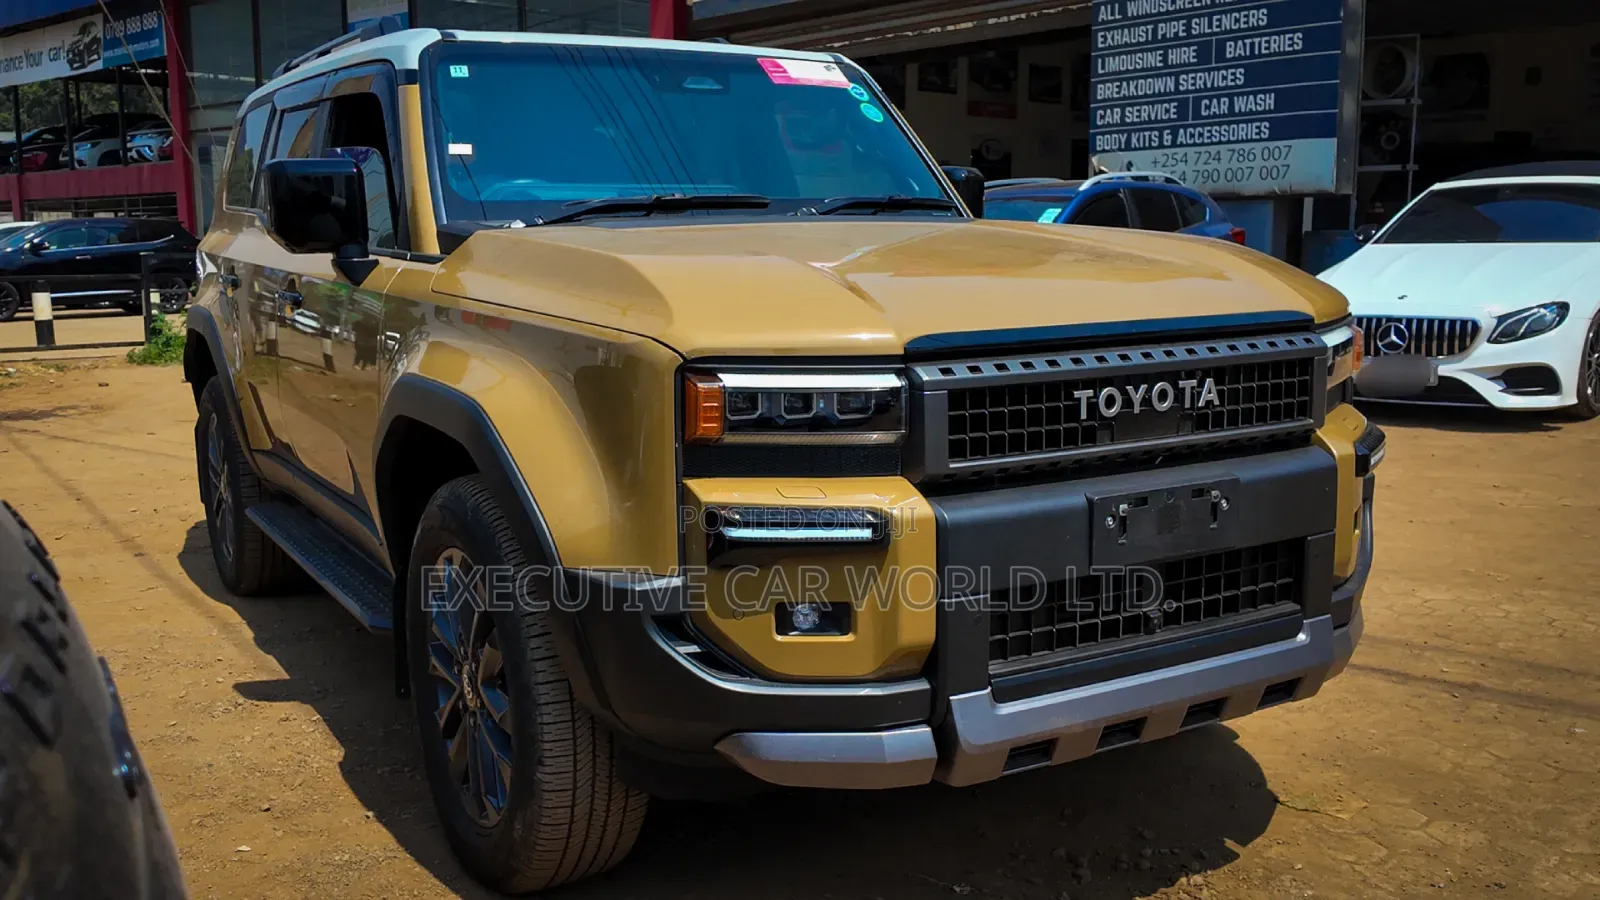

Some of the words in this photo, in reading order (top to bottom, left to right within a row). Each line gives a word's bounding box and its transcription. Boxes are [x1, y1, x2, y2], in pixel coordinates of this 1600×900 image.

[1098, 3, 1122, 21] ALL
[1097, 25, 1154, 48] EXHAUST
[1158, 20, 1187, 40] PIPE
[1191, 8, 1268, 35] SILENCERS
[24, 48, 43, 69] Your
[48, 39, 66, 62] car!
[1226, 32, 1303, 58] BATTERIES
[1097, 50, 1164, 74] LIMOUSINE
[1168, 46, 1198, 63] HIRE
[1097, 76, 1175, 100] BREAKDOWN
[1179, 68, 1245, 92] SERVICES
[1096, 107, 1121, 126] CAR
[1125, 102, 1178, 122] SERVICE
[1201, 97, 1229, 116] CAR
[1234, 93, 1275, 113] WASH
[1096, 133, 1128, 151] BODY
[1131, 130, 1160, 148] KITS
[1163, 128, 1172, 146] &
[1177, 122, 1270, 145] ACCESSORIES
[1151, 152, 1188, 168] +254
[1193, 150, 1222, 165] 724
[1227, 147, 1257, 163] 786
[1261, 145, 1292, 162] 007
[1192, 168, 1220, 184] 790
[1224, 166, 1253, 182] 007
[1259, 164, 1291, 181] 007
[1073, 377, 1220, 420] TOYOTA
